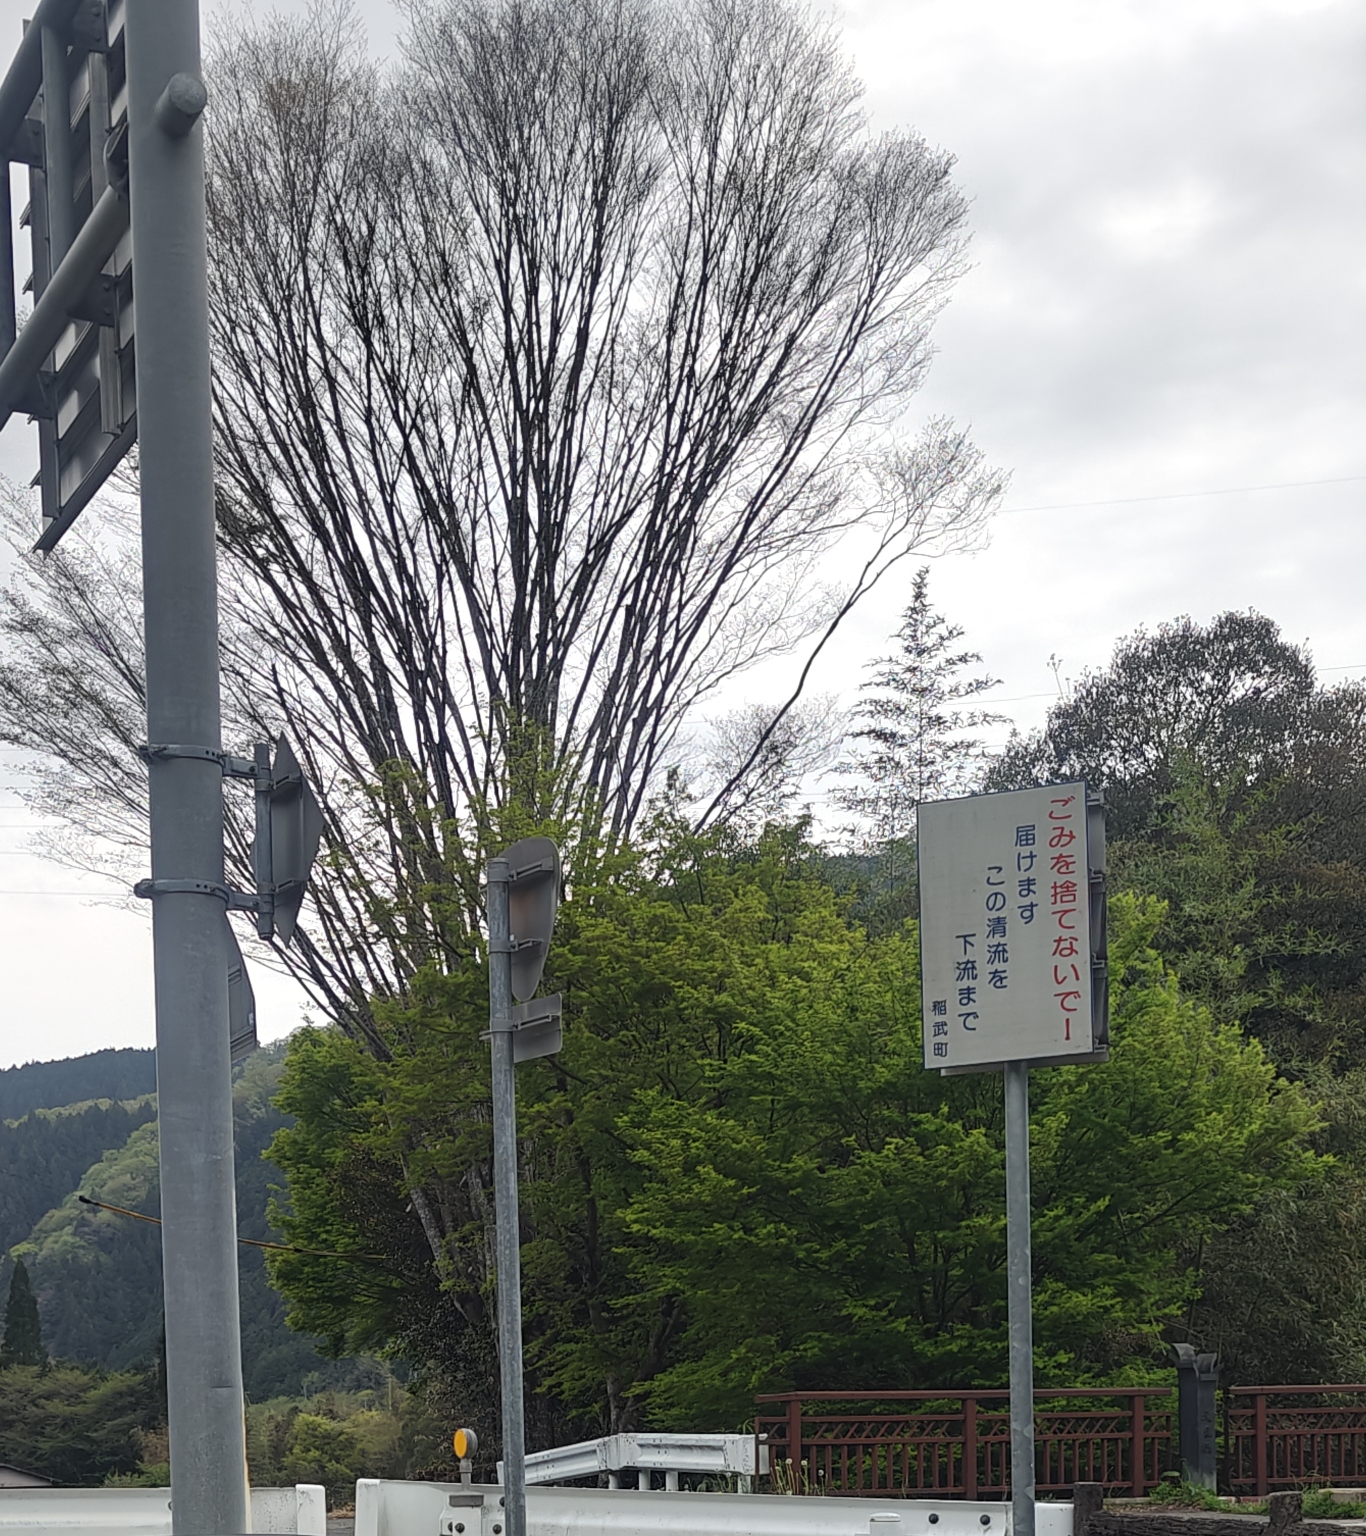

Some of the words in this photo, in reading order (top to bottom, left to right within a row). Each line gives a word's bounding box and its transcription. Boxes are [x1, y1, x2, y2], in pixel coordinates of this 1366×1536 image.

[1014, 824, 1039, 925] 届けます
[985, 865, 1009, 990] この清流を
[931, 999, 949, 1058] 稲武町
[955, 932, 980, 1032] 下流まで
